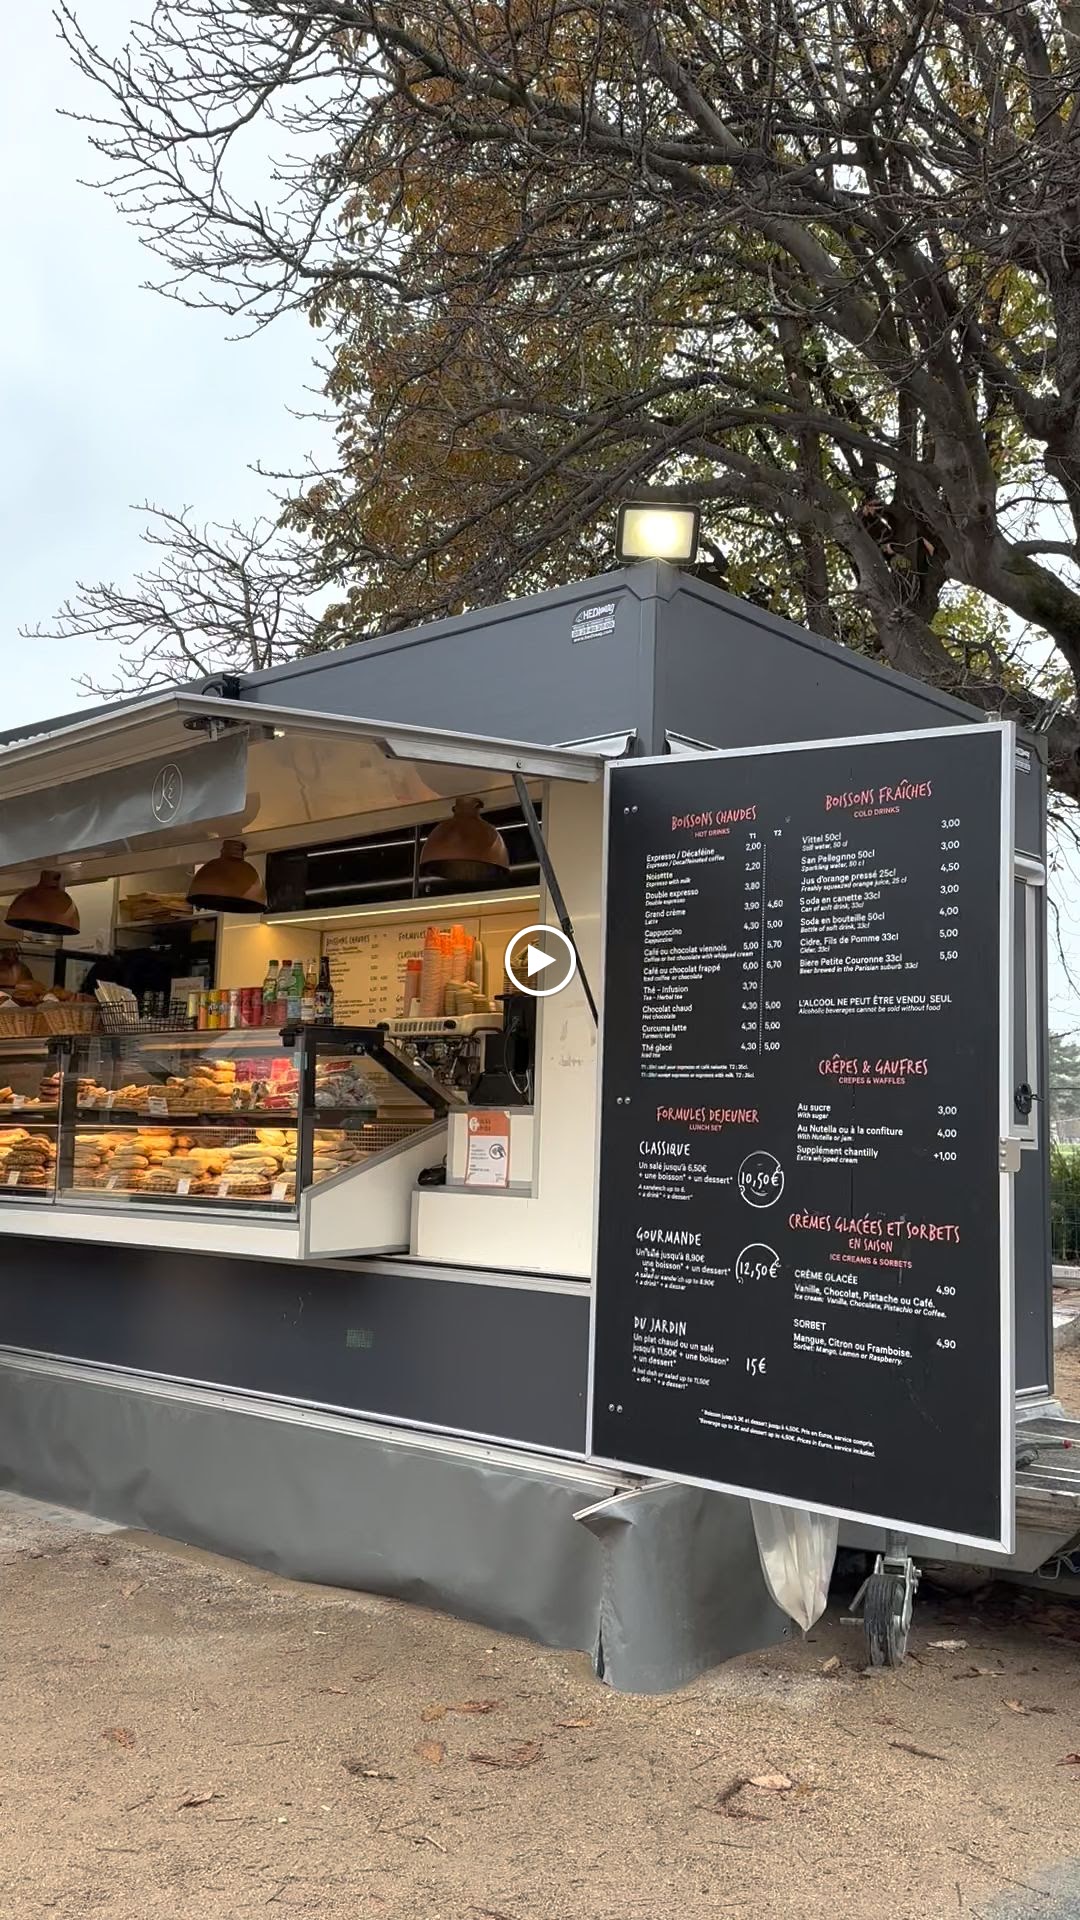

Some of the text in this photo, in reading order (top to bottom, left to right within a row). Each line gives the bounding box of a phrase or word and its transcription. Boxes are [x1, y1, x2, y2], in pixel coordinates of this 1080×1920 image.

[825, 779, 932, 810] BOISSONS FRAÎCHES
[854, 807, 899, 818] COLD DRINKS
[672, 806, 756, 831] BOISSONS CHAUDES
[941, 819, 960, 828] 3,00
[709, 828, 730, 836] DRINKS
[803, 833, 841, 844] Vittel 50cl
[746, 842, 761, 851] 2,00
[941, 841, 959, 850] 3,00
[647, 854, 675, 862] Expresso
[801, 850, 875, 864] San 50cl
[745, 862, 760, 871] 2,20
[941, 862, 959, 872] 4,50
[817, 873, 849, 883] d'orange
[851, 870, 877, 881] pressé
[879, 869, 896, 877] 25cl
[745, 882, 760, 891] 3,80
[940, 885, 959, 894] 3,00
[646, 889, 698, 899] Double expresso
[833, 894, 862, 902] canette
[864, 892, 880, 900] 33cl
[744, 902, 759, 910] 3,90
[645, 910, 664, 918] Grand
[939, 907, 958, 916] 4,00
[801, 918, 819, 926] Soda
[833, 914, 866, 923] bouteille
[868, 913, 885, 921] 50cl
[744, 922, 759, 930] 4,30
[767, 920, 783, 929] 5,00
[645, 928, 682, 937] Cappuccino
[939, 929, 958, 938] 5,00
[824, 936, 837, 944] Fils
[851, 935, 879, 943] Pomme
[882, 933, 898, 941] 33cl
[699, 944, 727, 952] viennois
[743, 942, 758, 950] 5,00
[767, 940, 782, 949] 5,70
[845, 956, 883, 964] Couronne
[886, 954, 902, 962] 33cl
[940, 951, 958, 960] 5,50
[669, 965, 697, 973] chocolat
[743, 962, 758, 970] 6,00
[644, 986, 655, 994] Thé
[742, 982, 757, 990] 3,70
[765, 1001, 781, 1010] 5,00
[799, 999, 834, 1007] L'ALCOOL
[896, 995, 925, 1004] VENDU
[931, 995, 952, 1003] SEUL
[643, 1005, 670, 1013] Chocolat
[742, 1002, 757, 1010] 4,30
[826, 1007, 855, 1015] beverages
[741, 1022, 757, 1031] 4,30
[765, 1021, 780, 1030] 5,00
[655, 1043, 672, 1052] glacé
[741, 1042, 756, 1051] 4,30
[764, 1042, 780, 1051] 5,00
[819, 1053, 857, 1075] CRÊPES
[875, 1059, 928, 1075] GAUFRES
[657, 1106, 759, 1123] FORMULES DEJEUNER
[938, 1106, 957, 1115] 3,00
[810, 1125, 836, 1134] Nutella
[851, 1126, 854, 1134] à
[858, 1126, 864, 1134] la
[867, 1127, 903, 1135] confiture
[937, 1129, 956, 1138] 4,00
[640, 1141, 690, 1156] CLASSIQUE
[797, 1145, 878, 1158] Supplément chantilly
[934, 1152, 956, 1161] +1,00
[742, 1172, 779, 1189] 10,50€
[789, 1208, 960, 1243] CRÈMES GLACÉES ET SORBETS
[637, 1227, 701, 1246] GOURMANDE
[849, 1238, 892, 1252] EN SAISON
[842, 1255, 871, 1264] CREAMS
[879, 1259, 912, 1268] SORBETS
[740, 1262, 777, 1280] 12,50€
[825, 1272, 858, 1284] GLACÉE
[824, 1288, 910, 1305] Chocolat, Pistache ou
[634, 1316, 686, 1336] DU JARDIN
[794, 1319, 826, 1331] SORBET
[634, 1333, 642, 1341] Un
[644, 1335, 656, 1343] plat
[658, 1338, 678, 1346] chaud
[701, 1344, 714, 1352] salé
[794, 1333, 912, 1358] Mangue, Citron ou Framboise.
[747, 1358, 766, 1375] 15€
